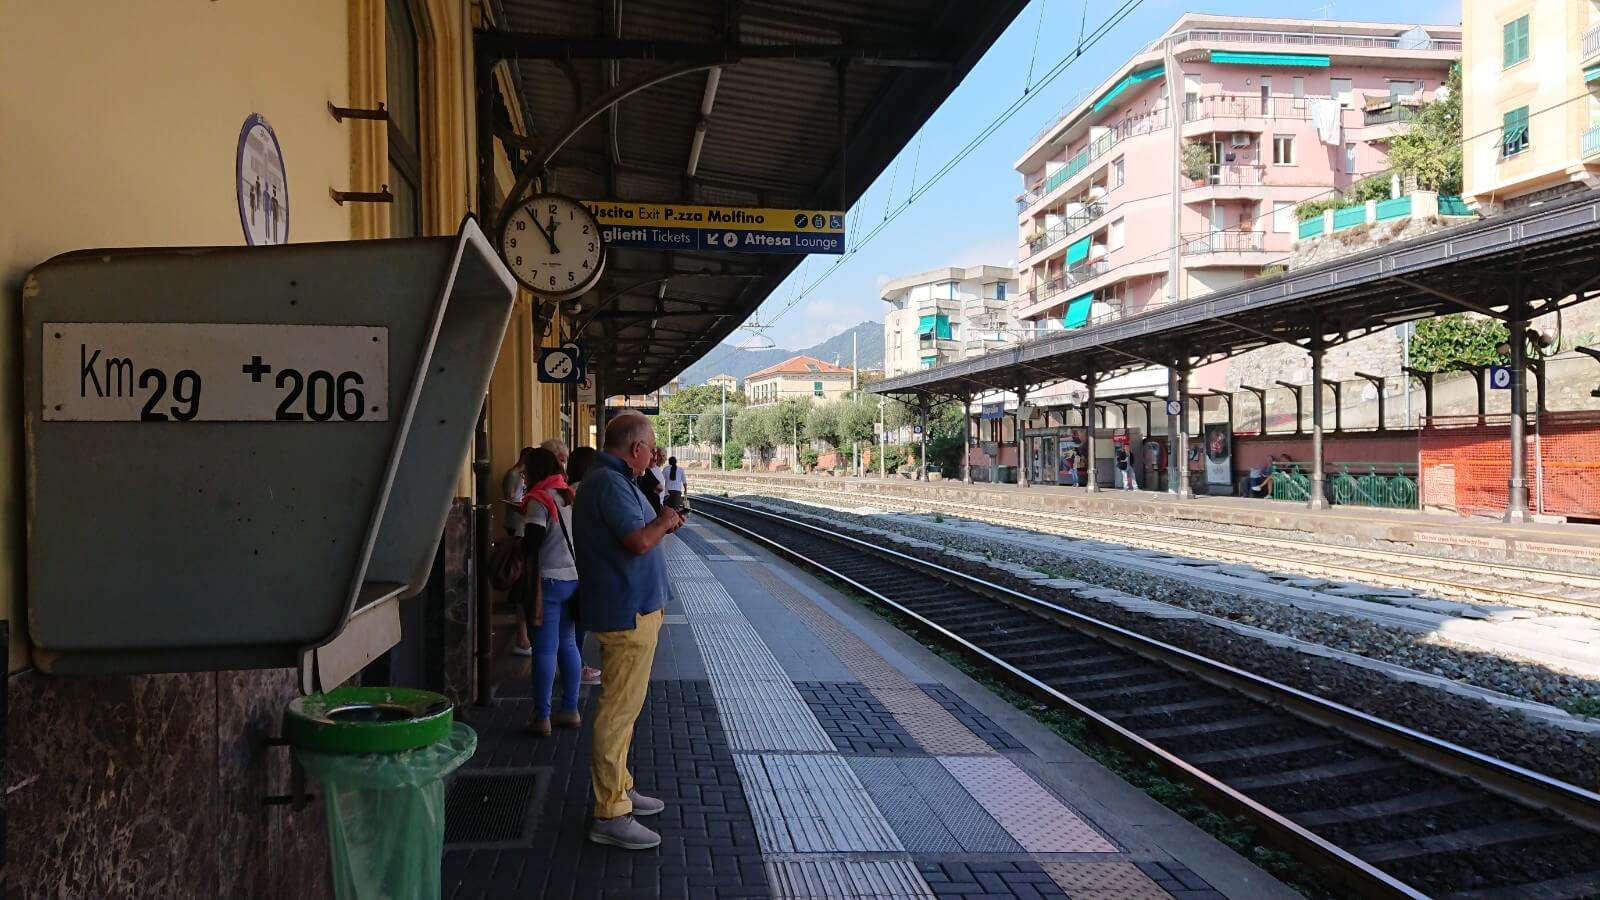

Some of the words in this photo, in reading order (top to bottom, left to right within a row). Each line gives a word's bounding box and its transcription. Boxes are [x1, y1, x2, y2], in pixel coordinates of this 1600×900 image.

[548, 204, 558, 215] 12
[588, 204, 634, 218] Uscita
[638, 206, 660, 220] Exit
[664, 207, 703, 221] P.zza
[707, 209, 765, 224] Molfino
[569, 210, 574, 221] 1
[516, 221, 526, 231] 10
[582, 224, 590, 234] 2
[602, 226, 648, 243] glietti
[651, 228, 691, 244] Tickets
[510, 238, 517, 248] 9
[744, 232, 792, 246] Attesa
[795, 235, 838, 250] Lounge
[588, 242, 595, 252] 3
[516, 256, 522, 266] 8
[582, 259, 589, 269] 4
[531, 269, 538, 279] 7
[568, 271, 575, 282] 5
[549, 275, 556, 286] 6
